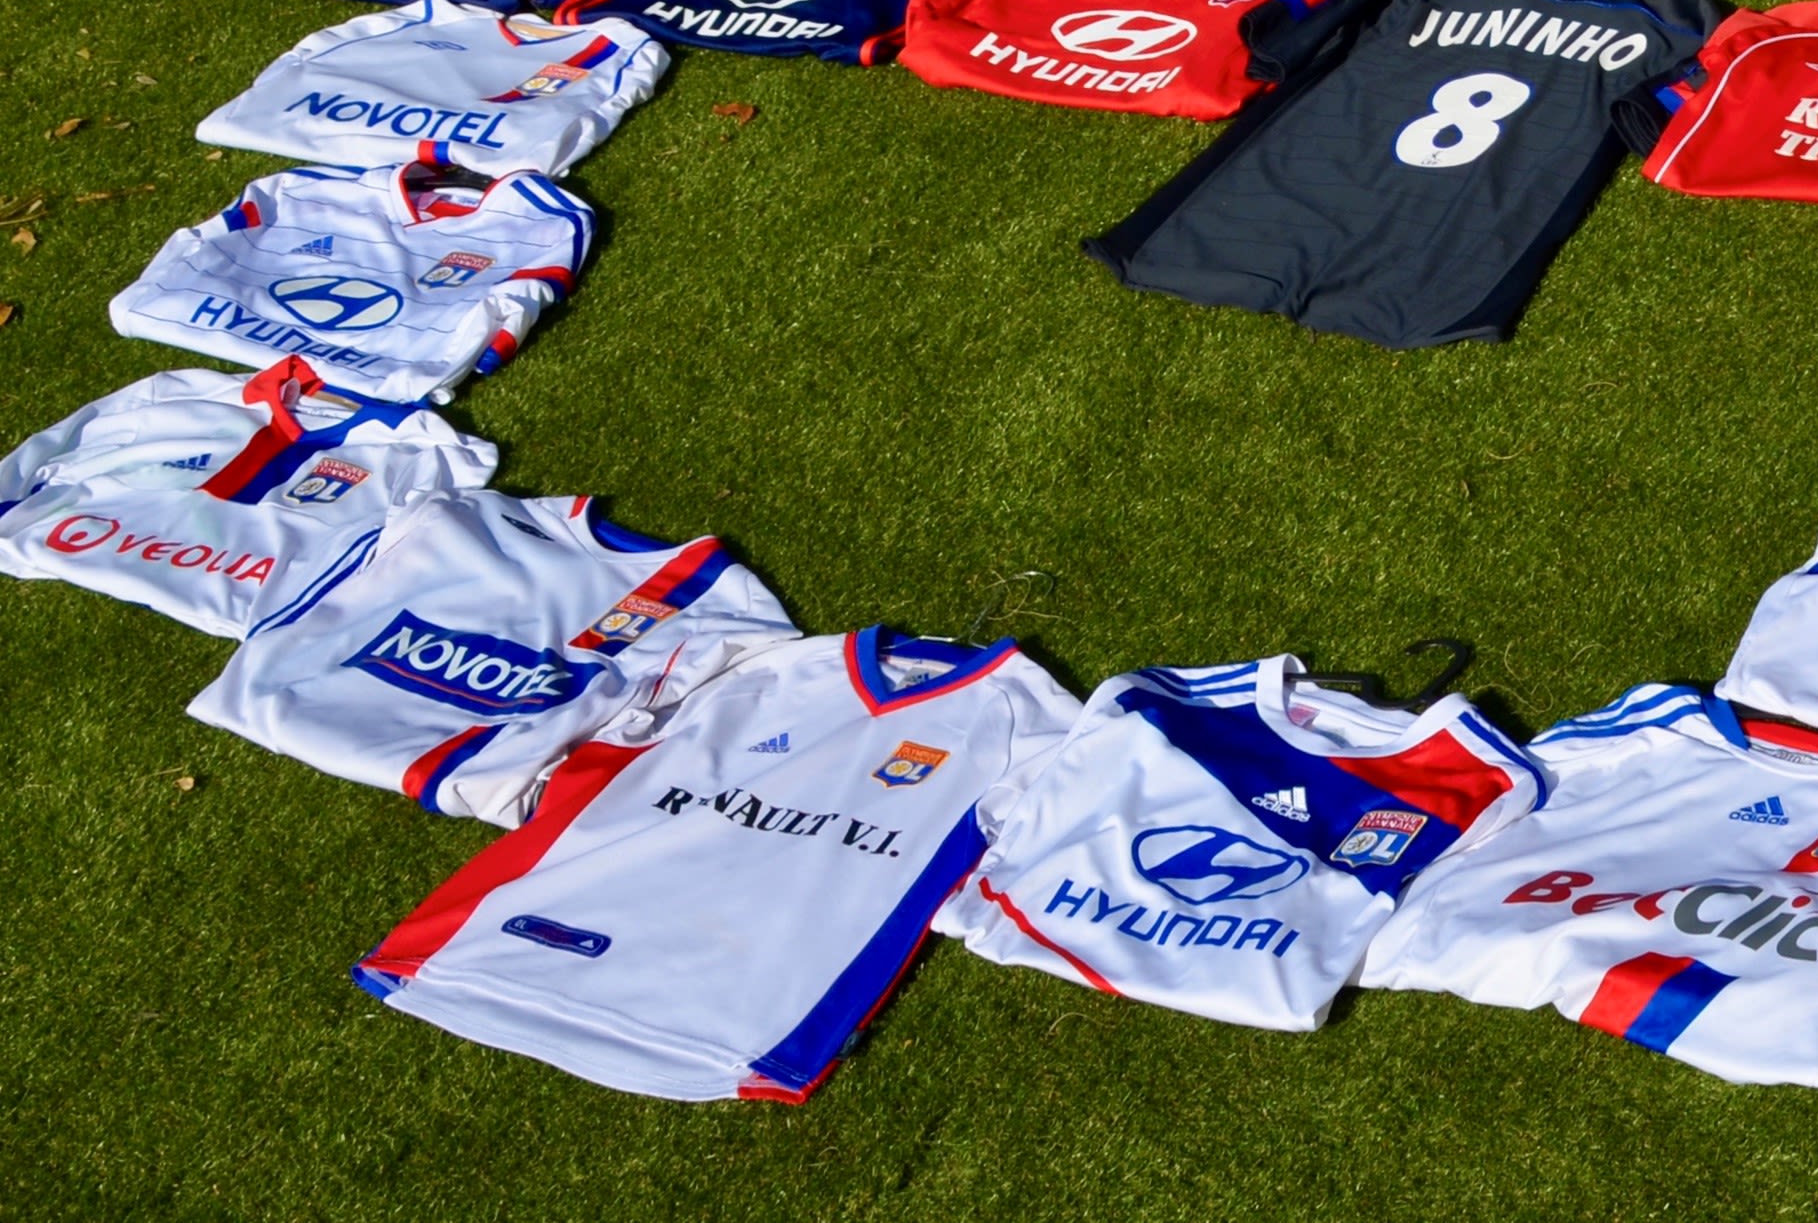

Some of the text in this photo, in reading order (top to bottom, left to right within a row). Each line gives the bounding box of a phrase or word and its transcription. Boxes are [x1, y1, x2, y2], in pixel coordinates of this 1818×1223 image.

[645, 1, 843, 39] HYUNDAI
[1410, 7, 1648, 71] JUNINHO
[970, 32, 1179, 95] HYUNDAI
[284, 90, 505, 148] NOVOTEL
[1393, 72, 1532, 168] 8
[189, 297, 381, 370] HYUNDAI
[293, 477, 343, 500] OL
[117, 532, 275, 587] VEOLIA
[600, 613, 647, 638] OL
[371, 626, 574, 698] NOVOTEL
[884, 759, 926, 781] OL
[652, 786, 838, 838] RNAULT
[1252, 795, 1311, 823] adidas
[1730, 811, 1790, 826] adidas
[1341, 831, 1398, 858] OL
[1045, 879, 1299, 957] HYUNDAI
